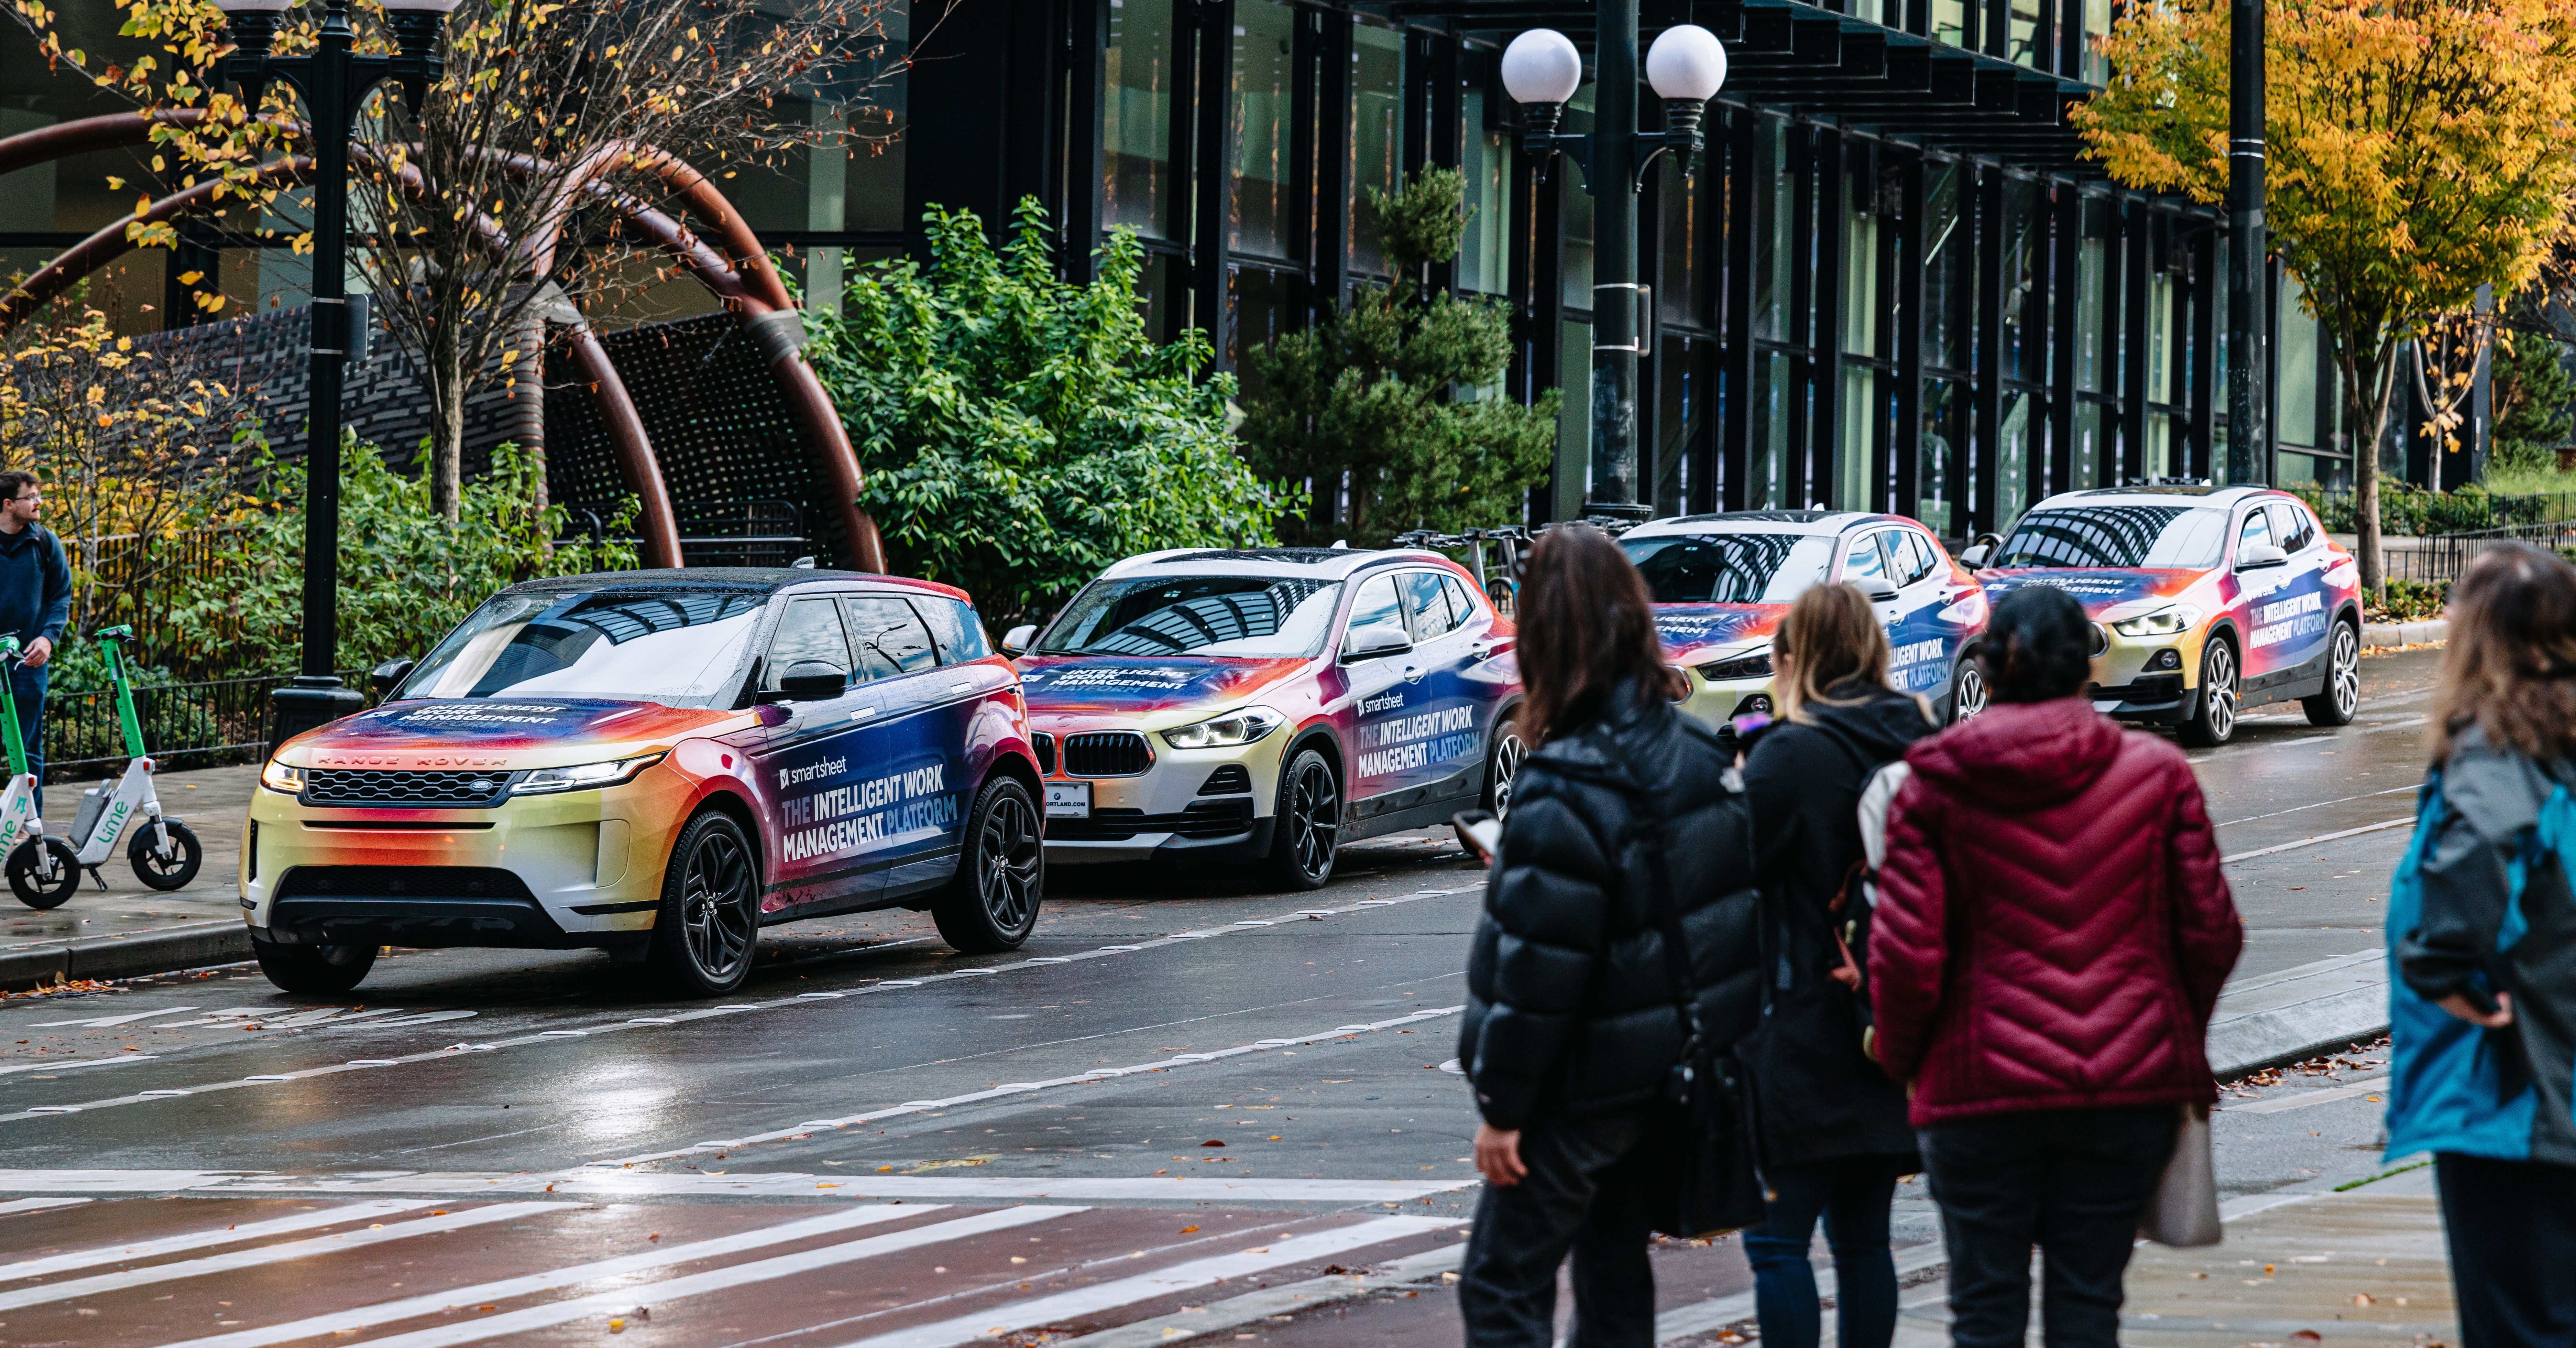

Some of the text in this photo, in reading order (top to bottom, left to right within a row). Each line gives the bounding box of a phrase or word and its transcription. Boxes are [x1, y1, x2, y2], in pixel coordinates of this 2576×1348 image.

[2250, 591, 2321, 627] THE INTELLIGENT WORK
[2250, 612, 2326, 649] MANAGEMENT PLATFORM
[1919, 638, 1943, 662] WORK
[1049, 679, 1188, 689] MANAGEMENT
[1066, 669, 1190, 678] INTELLIGENT
[1909, 660, 1949, 687] PLATFORM
[1366, 692, 1404, 713] smartsheet
[398, 714, 558, 724] MANAGEMENT
[1360, 705, 1473, 750] THE INTELLIGENT WORK
[318, 756, 507, 766] RANGE ROVER
[1358, 731, 1480, 779] MANAGEMENT PLATFORM
[791, 756, 847, 784] smartsheet
[782, 764, 944, 828] THE INTELLIGENT WORK
[96, 801, 128, 843] Lime
[783, 794, 957, 863] MANAGEMENT PLATFORM
